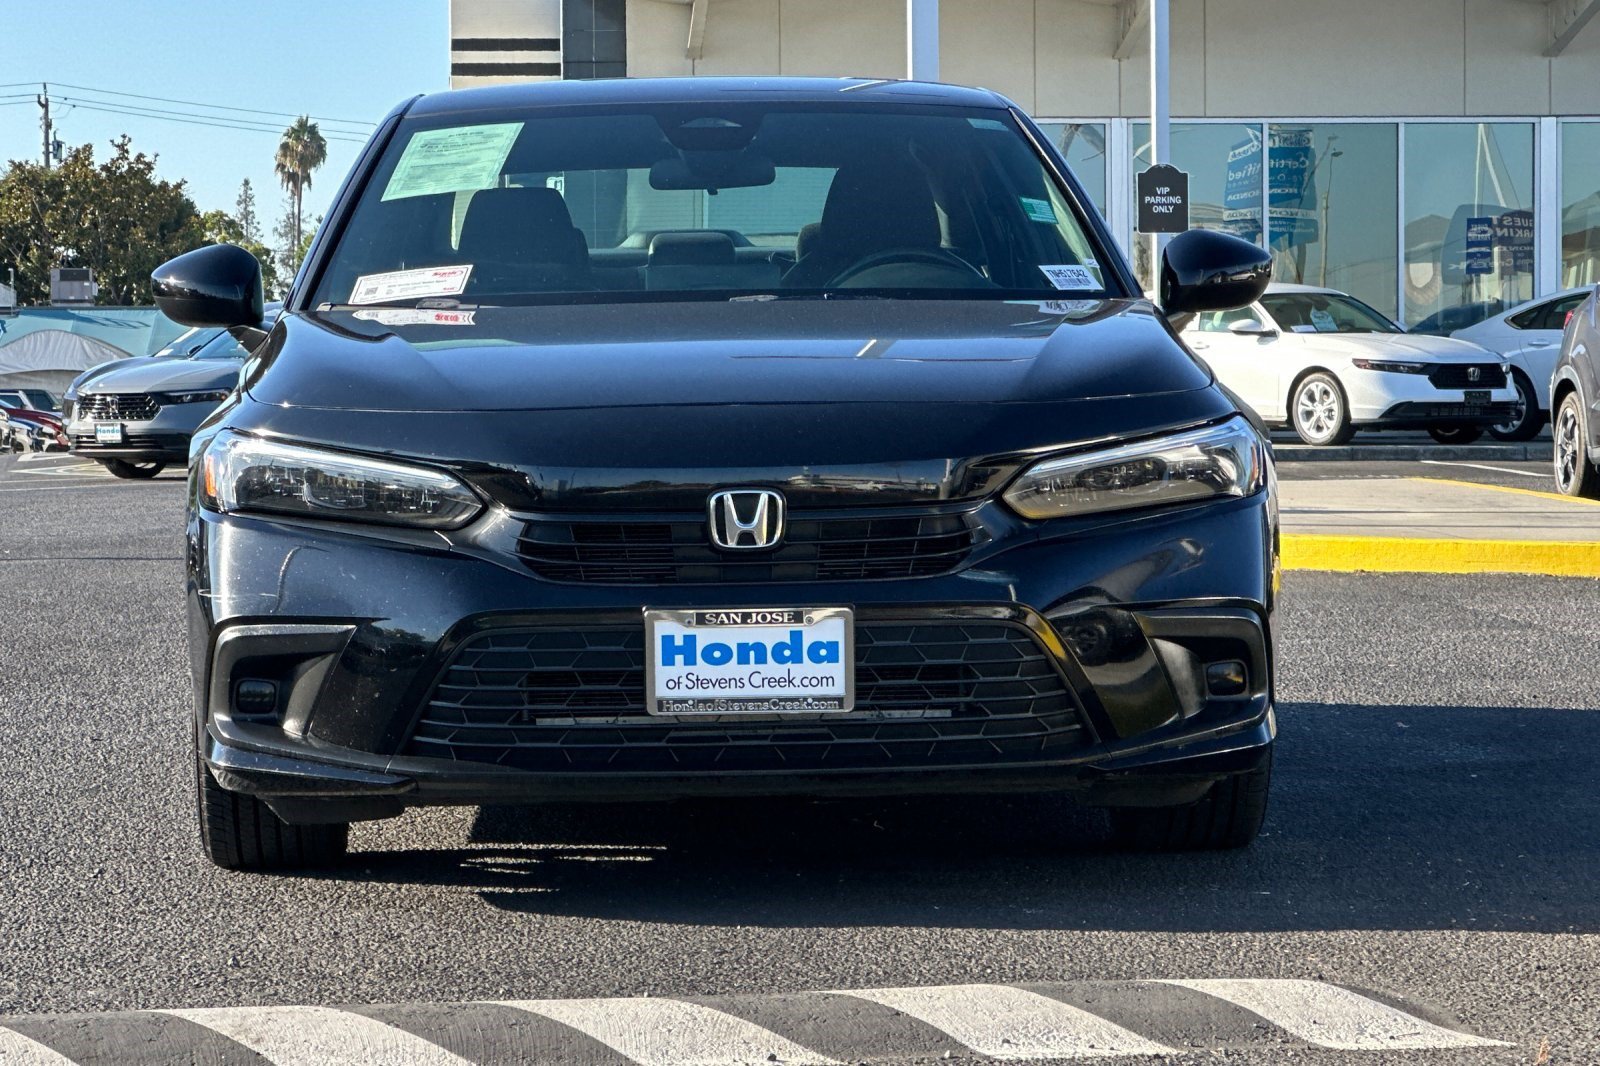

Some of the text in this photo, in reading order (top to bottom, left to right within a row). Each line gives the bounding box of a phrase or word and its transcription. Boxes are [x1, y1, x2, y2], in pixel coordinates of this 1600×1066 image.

[1156, 186, 1170, 195] VIP
[1144, 195, 1182, 204] PARKING
[1152, 205, 1174, 213] ONLY
[705, 611, 795, 625] SAN JOSE
[660, 630, 840, 667] Honda
[665, 668, 835, 691] of Stevens Creek.com
